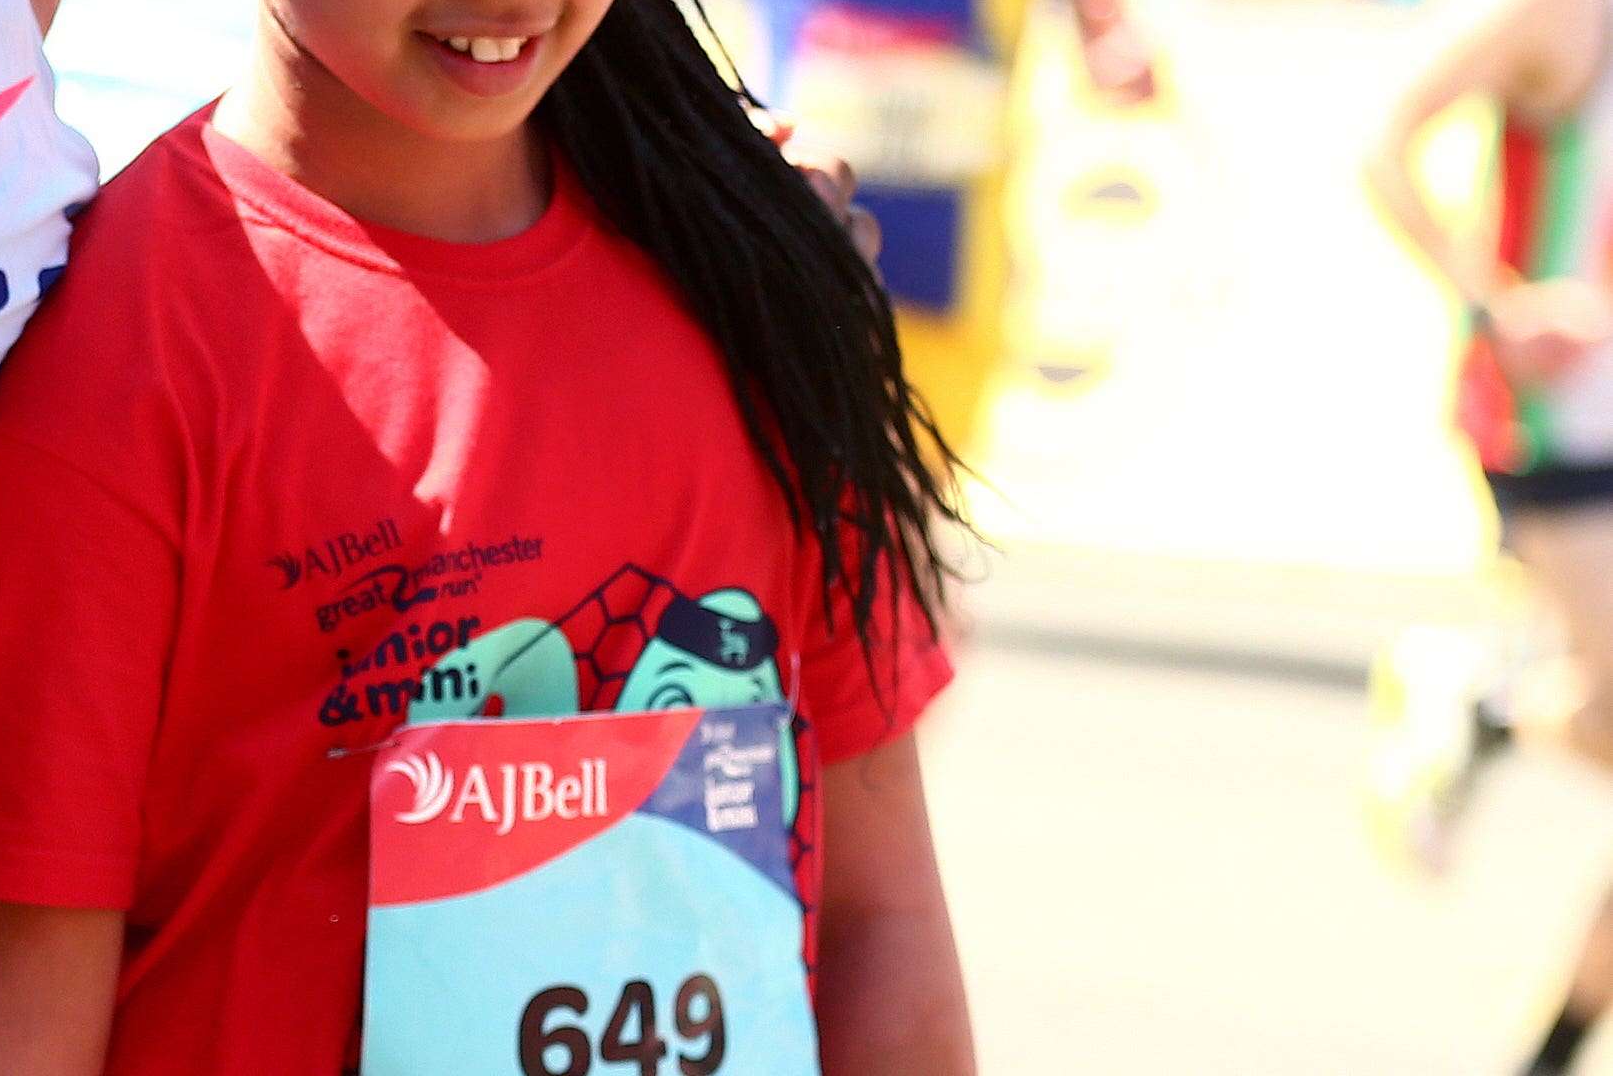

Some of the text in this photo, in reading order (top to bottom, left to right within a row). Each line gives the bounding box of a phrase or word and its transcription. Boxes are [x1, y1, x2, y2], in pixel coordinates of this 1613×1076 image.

[316, 578, 479, 633] great run
[450, 757, 609, 836] AJBell
[519, 972, 726, 1076] 649
